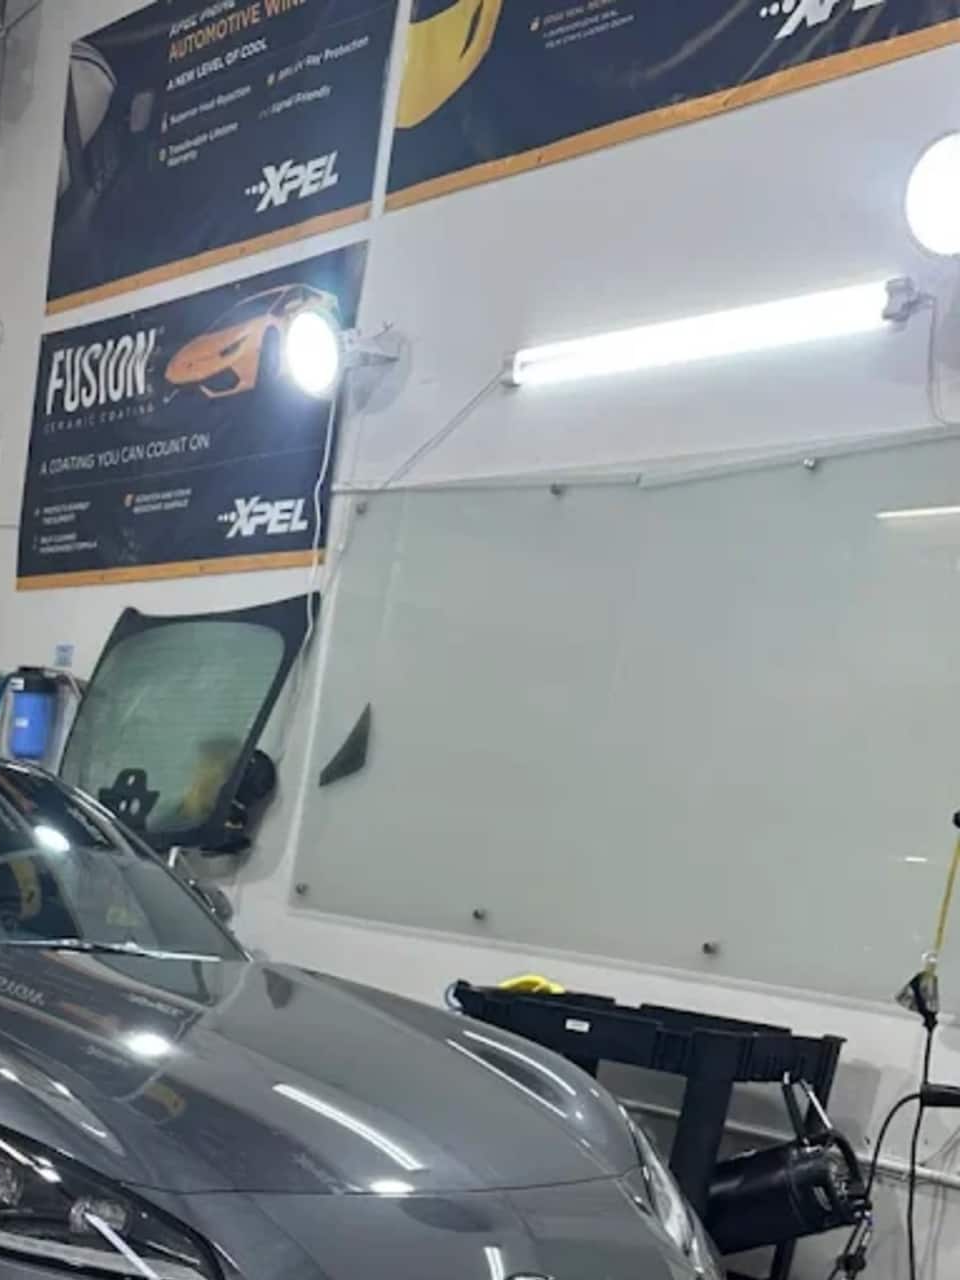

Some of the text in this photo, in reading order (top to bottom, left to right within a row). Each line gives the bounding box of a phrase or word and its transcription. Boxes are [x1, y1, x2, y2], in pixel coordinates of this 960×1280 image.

[168, 2, 261, 62] AUTOMOTIVE
[324, 35, 369, 61] Protection
[166, 37, 267, 92] A NEW LEVEL OF COOL
[256, 151, 339, 213] XPEL
[46, 328, 156, 416] FUSION
[41, 433, 210, 475] A COATING YOU CAN COUNT ON
[227, 496, 308, 539] XPEL
